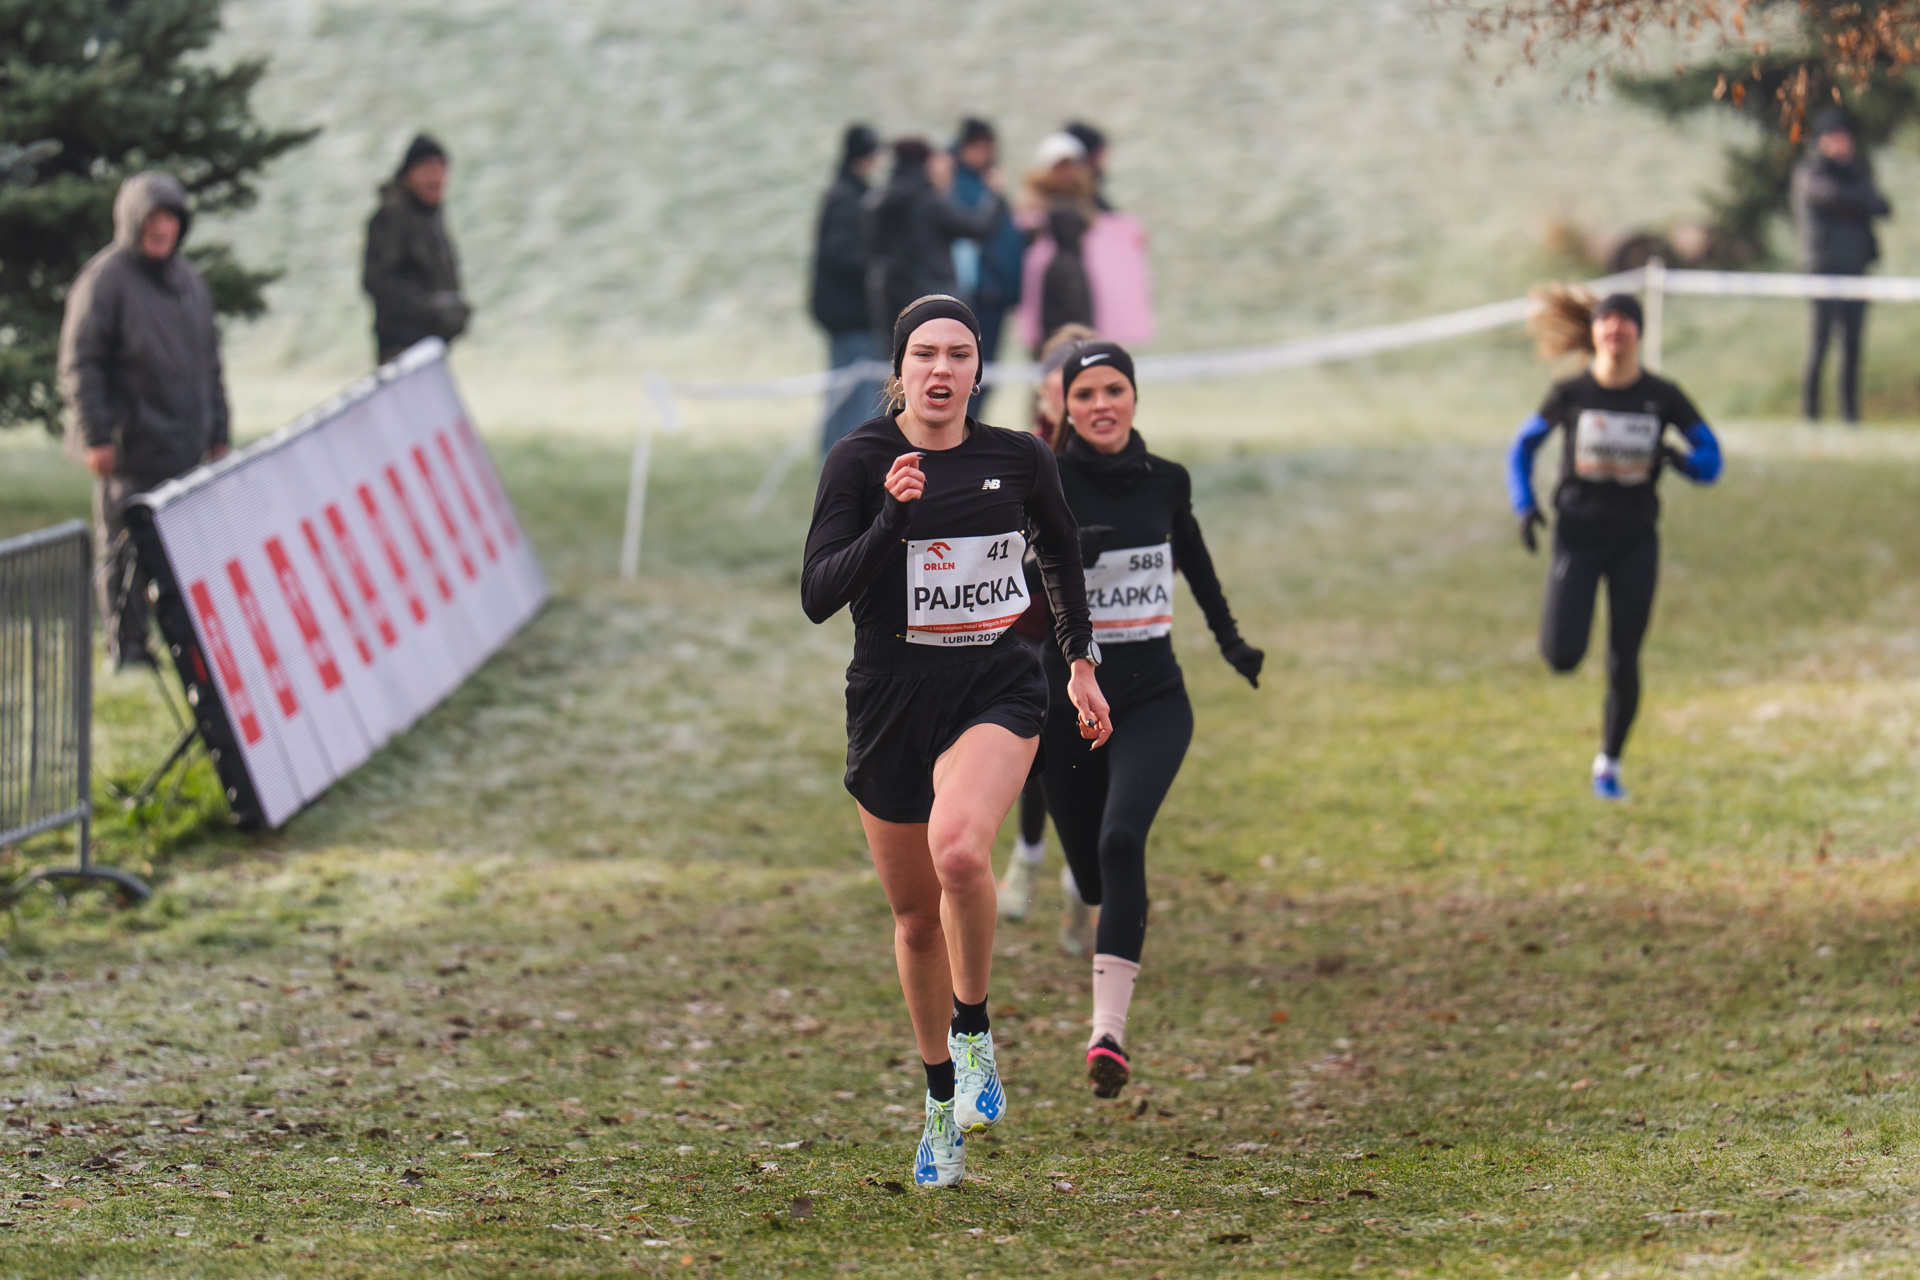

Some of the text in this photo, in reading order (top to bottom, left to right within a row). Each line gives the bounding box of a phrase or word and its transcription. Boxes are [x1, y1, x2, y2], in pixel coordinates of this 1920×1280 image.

[986, 539, 1010, 561] 41
[923, 562, 955, 571] ORLEN
[1128, 552, 1163, 571] 588
[914, 575, 1024, 613] PAJĘCKA
[1086, 583, 1168, 608] ZŁAPKA
[942, 634, 975, 645] LUBIN
